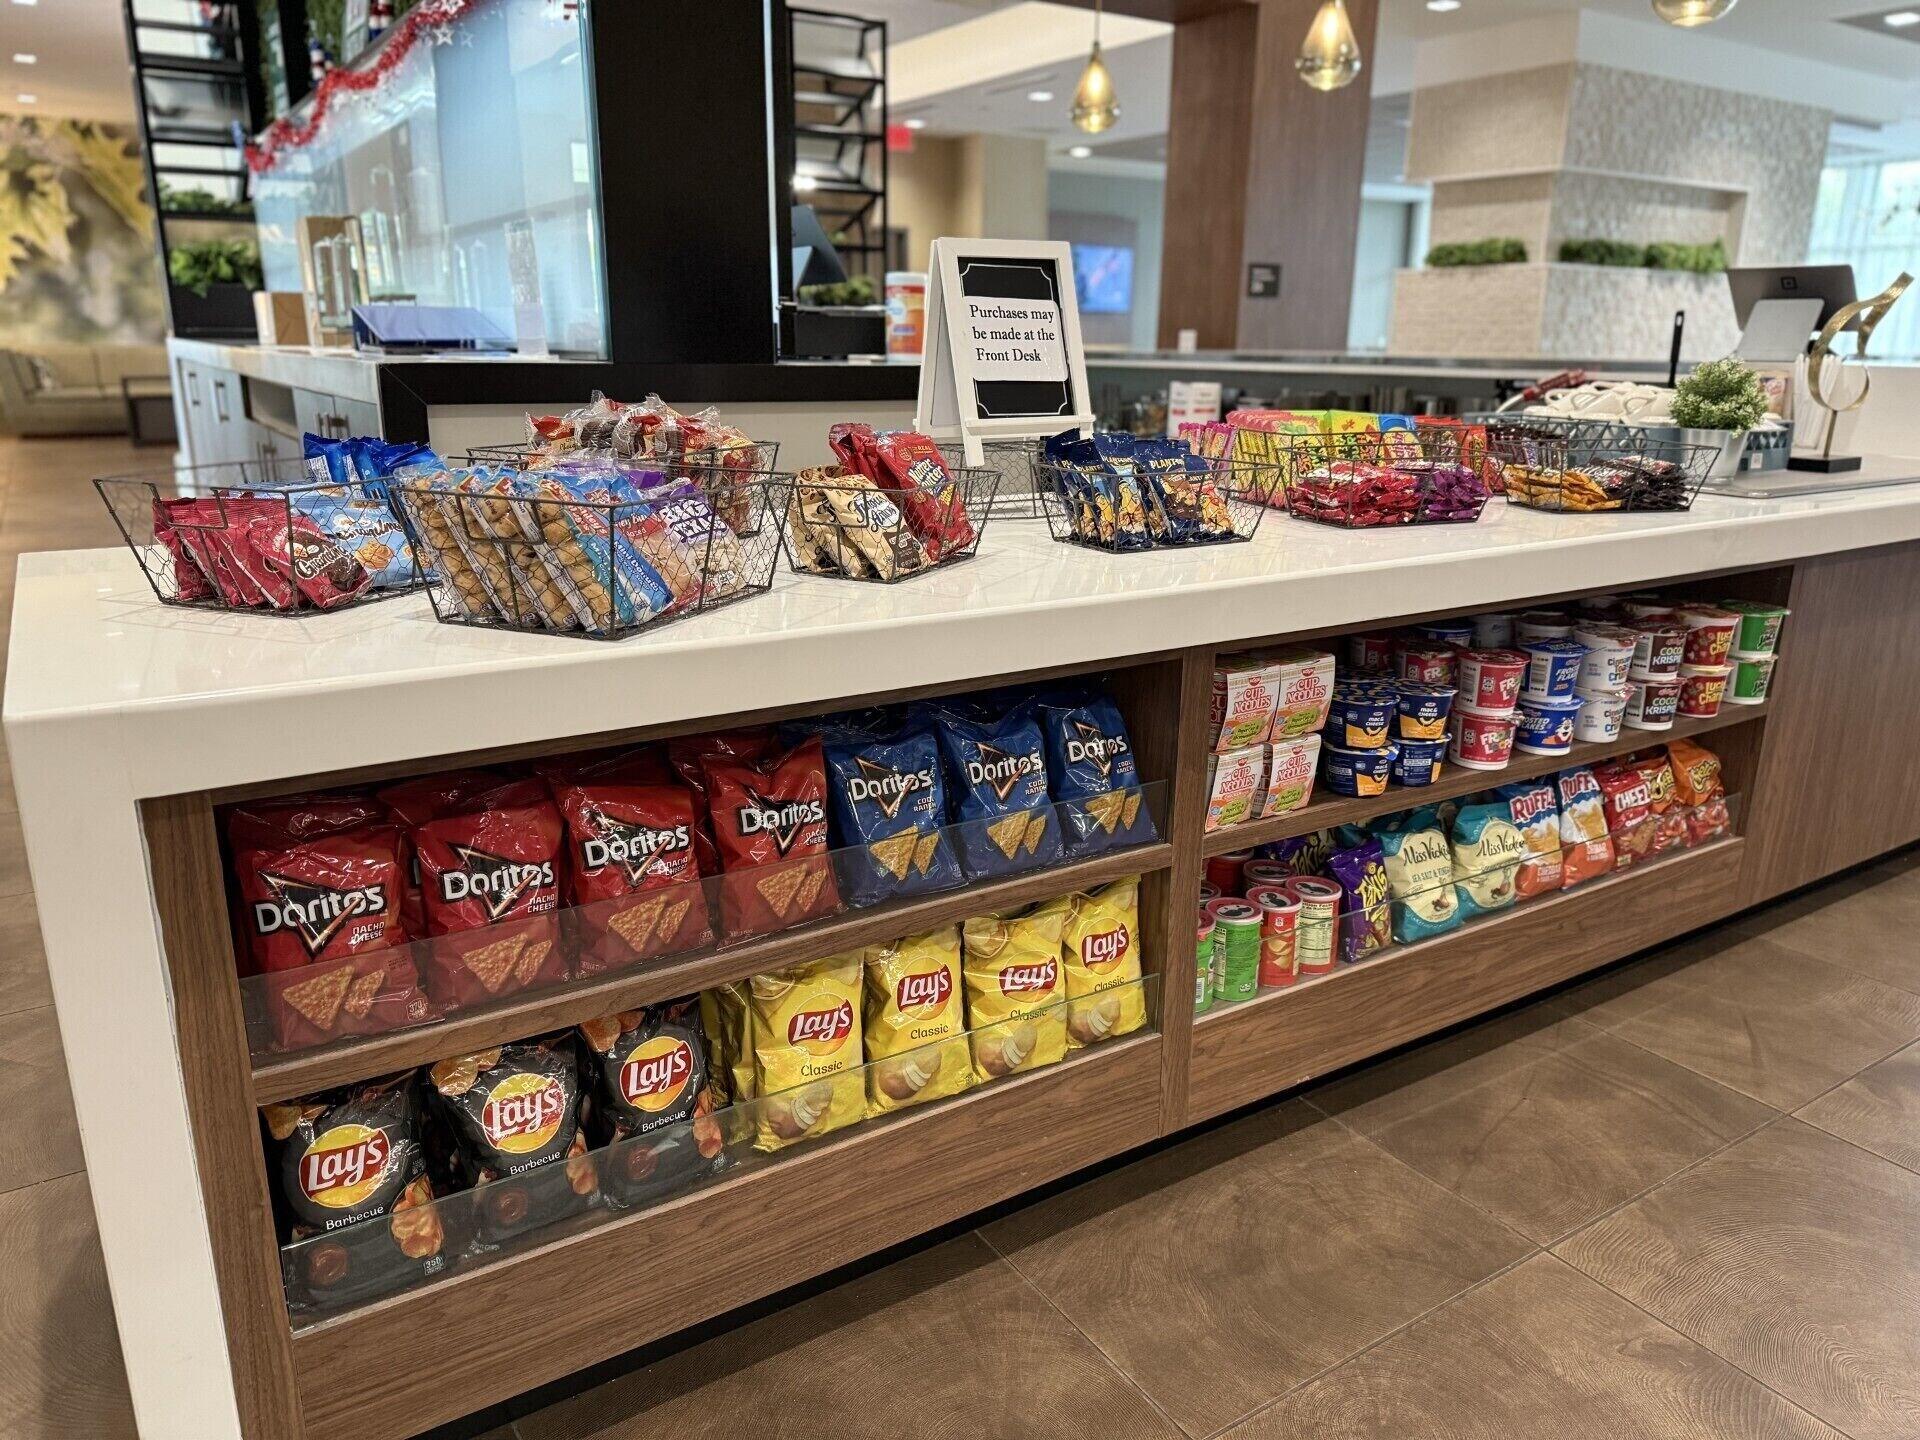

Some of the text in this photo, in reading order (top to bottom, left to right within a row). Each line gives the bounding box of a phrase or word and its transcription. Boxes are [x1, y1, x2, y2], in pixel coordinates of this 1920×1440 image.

[970, 305, 1054, 323] Purchases may
[972, 326, 1055, 341] be made at the
[976, 348, 1042, 362] Front Desk
[1243, 686, 1265, 701] CUP
[1296, 677, 1320, 691] CUP
[1285, 685, 1326, 704] NOODLES
[1233, 695, 1272, 715] NOODLES
[1067, 735, 1128, 763] Doritos
[969, 751, 1042, 784] Doritos
[1286, 753, 1306, 768] CUP
[1231, 766, 1251, 781] CUP
[1276, 763, 1311, 782] NOODLES
[850, 769, 932, 801] Doritos
[1220, 775, 1255, 794] NOODLES
[741, 800, 824, 834] Doritos
[585, 825, 690, 867] Doritos
[1403, 845, 1429, 866] Miss
[1476, 839, 1501, 857] Miss
[443, 862, 554, 900] Doritos
[527, 900, 557, 913] CHEESE
[529, 893, 556, 904] NACHO
[256, 886, 385, 932] Doritos
[352, 922, 385, 935] NACHO
[1084, 928, 1127, 963] Lay's
[1002, 962, 1057, 992] Lay's
[900, 970, 949, 1005] Lay's
[791, 1006, 850, 1042] Lay's
[910, 1024, 949, 1040] Classic
[628, 1049, 687, 1097] Lay's
[800, 1061, 843, 1077] Classic
[490, 1086, 558, 1141] Lay's
[642, 1110, 687, 1133] Barbecue
[308, 1137, 383, 1192] Lay's
[509, 1151, 561, 1176] Barbecue
[325, 1205, 384, 1230] Barbecue
[425, 1256, 441, 1268] 350
